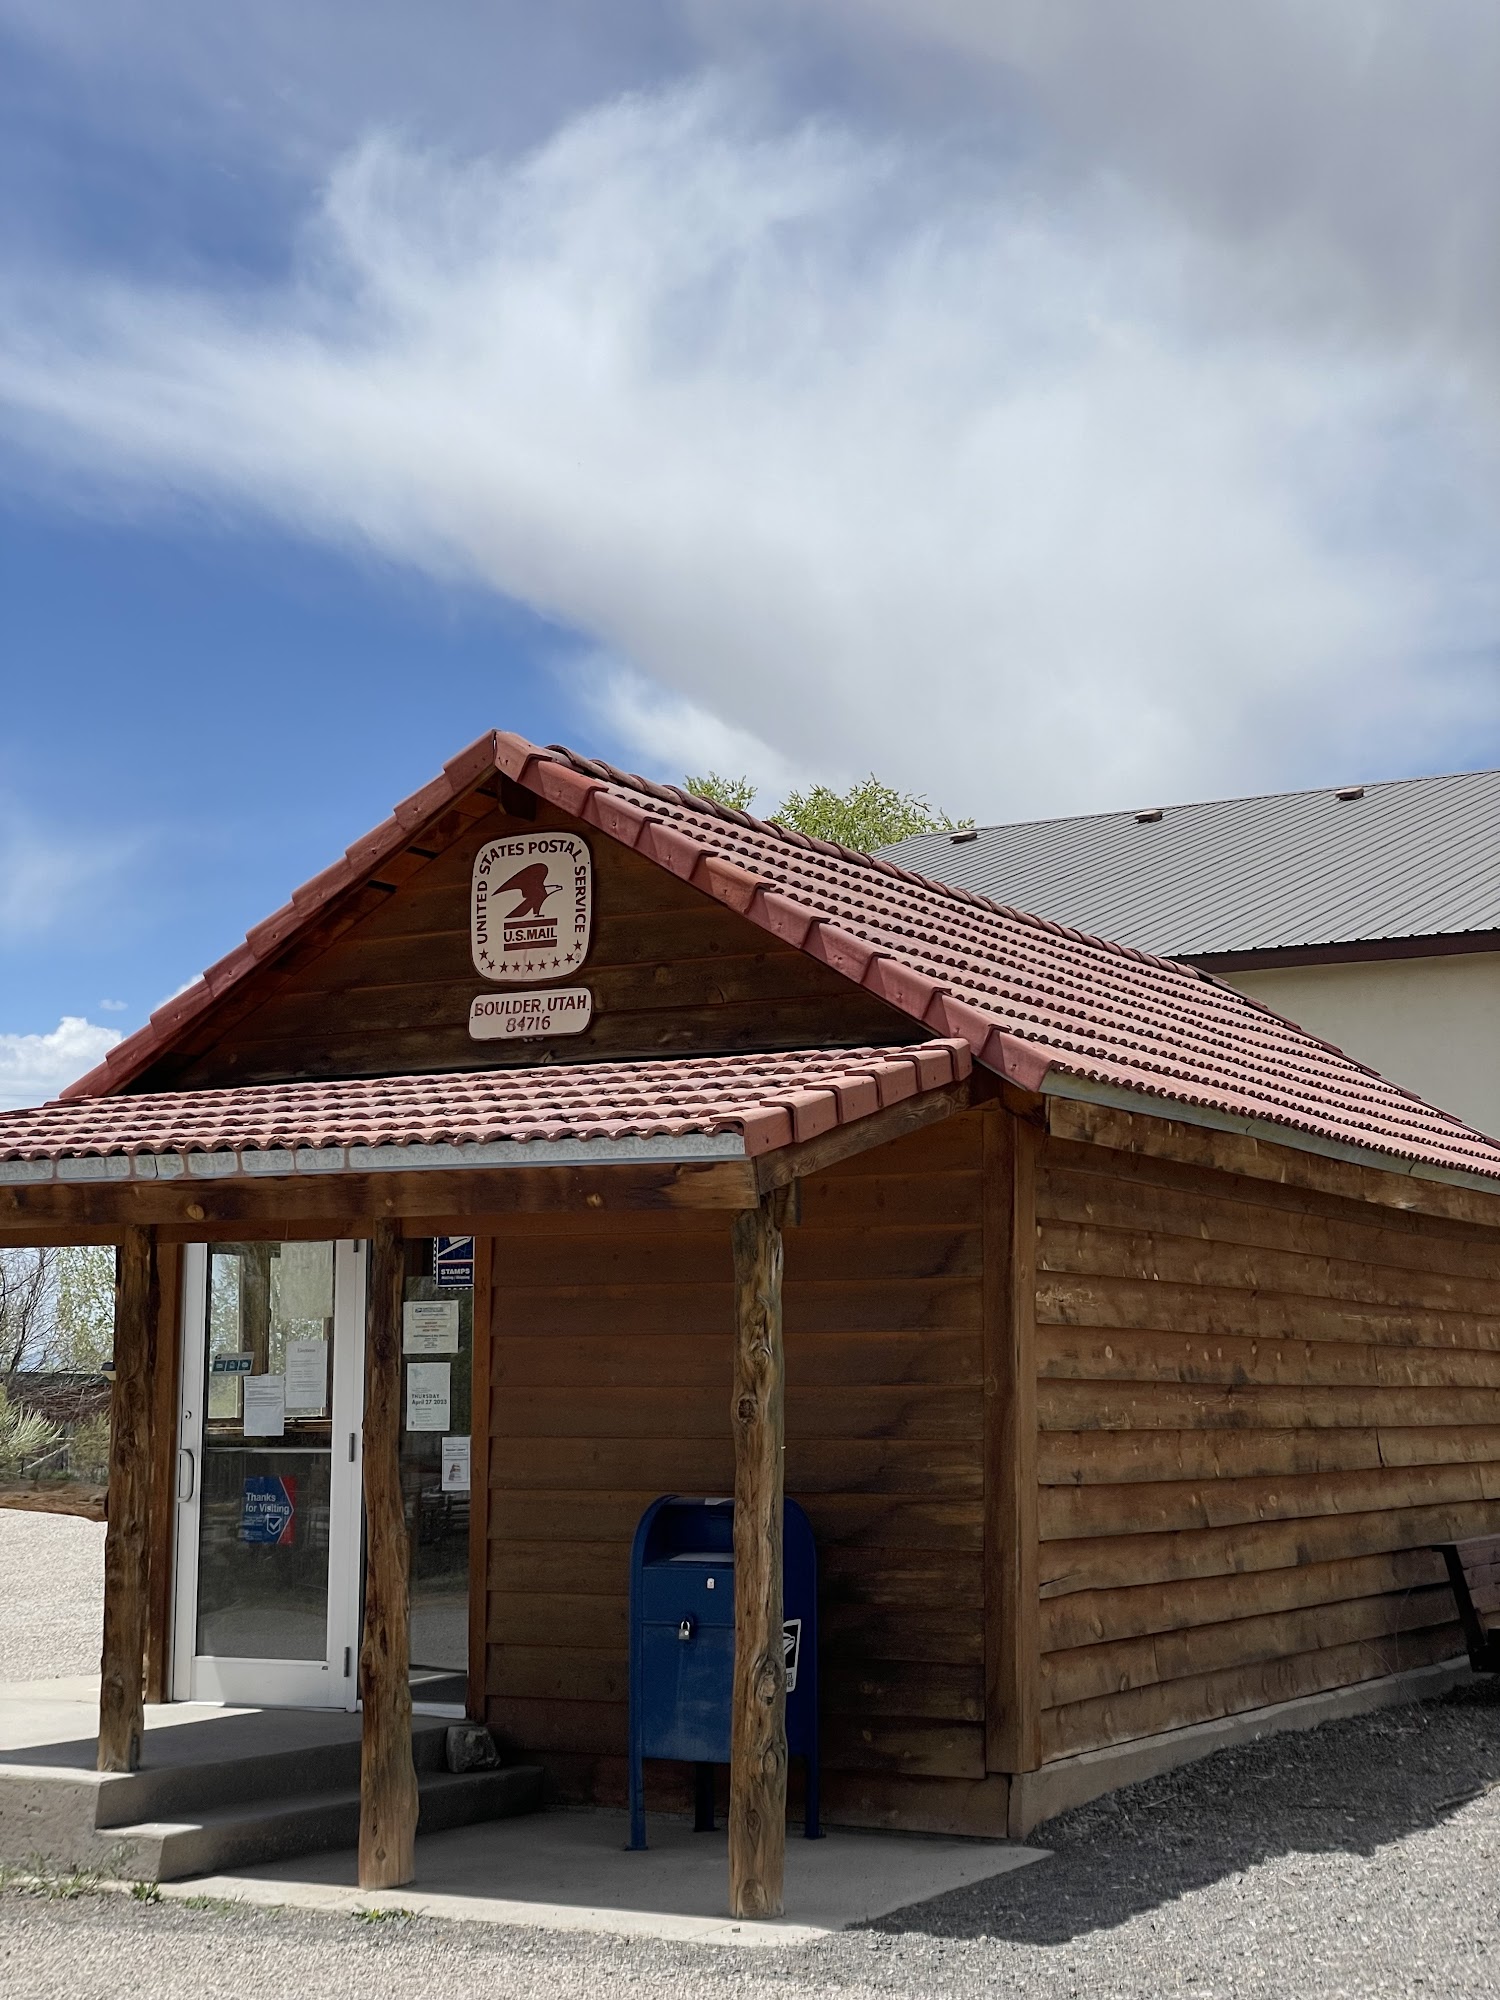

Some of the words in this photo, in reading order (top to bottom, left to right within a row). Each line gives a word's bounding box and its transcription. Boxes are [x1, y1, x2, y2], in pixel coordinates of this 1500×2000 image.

[479, 842, 525, 875] STATES
[528, 839, 582, 863] POSTAL
[574, 865, 587, 933] SERVICE
[476, 880, 488, 945] UNITED
[547, 995, 587, 1014] UTAH
[505, 1015, 551, 1033] 84716
[246, 1492, 276, 1502] Thanks
[245, 1503, 257, 1512] for
[259, 1503, 290, 1515] Visiting
